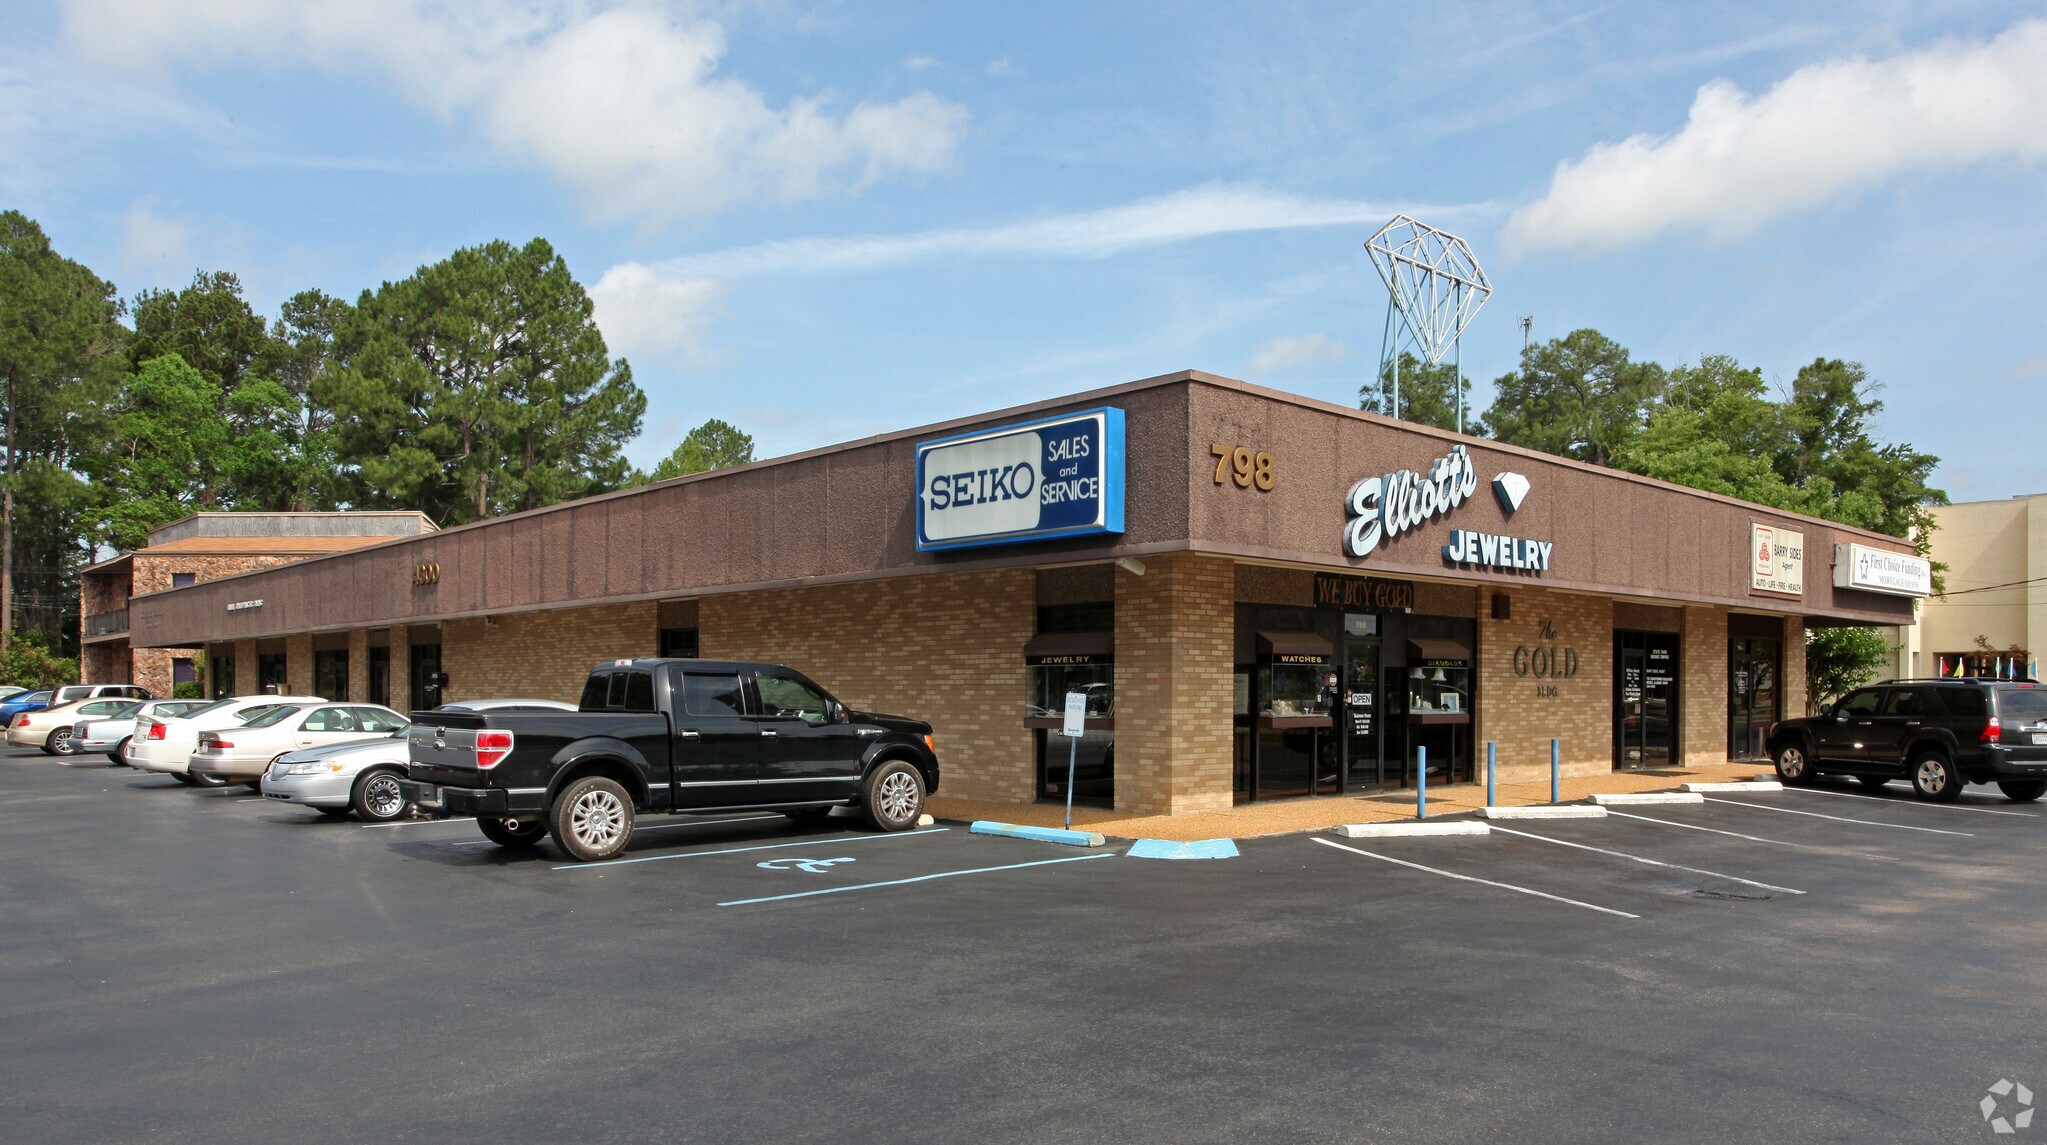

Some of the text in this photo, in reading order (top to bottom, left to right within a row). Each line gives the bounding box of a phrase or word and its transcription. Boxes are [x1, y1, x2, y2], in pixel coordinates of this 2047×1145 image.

[1048, 435, 1090, 463] SALES
[1059, 462, 1078, 477] and
[1211, 443, 1275, 491] 798
[930, 461, 1035, 510] SEIKO
[1041, 476, 1098, 505] SERVICE
[1343, 445, 1477, 557] Elliott's
[1443, 530, 1553, 571] JEWELRY
[1774, 544, 1802, 561] BARRY SIDES
[1782, 562, 1793, 571] Agent
[1870, 554, 1883, 570] First
[1884, 556, 1901, 573] Choice
[1902, 560, 1921, 579] Funding
[1318, 577, 1412, 609] WE BUY GOLD
[1755, 578, 1766, 588] AUTO
[1788, 583, 1801, 592] HEALTH
[1539, 620, 1558, 639] The
[1041, 656, 1089, 664] JEWELRY
[1281, 655, 1322, 663] WATCHES
[1514, 645, 1580, 678] GOLD
[1353, 694, 1371, 704] OPEN
